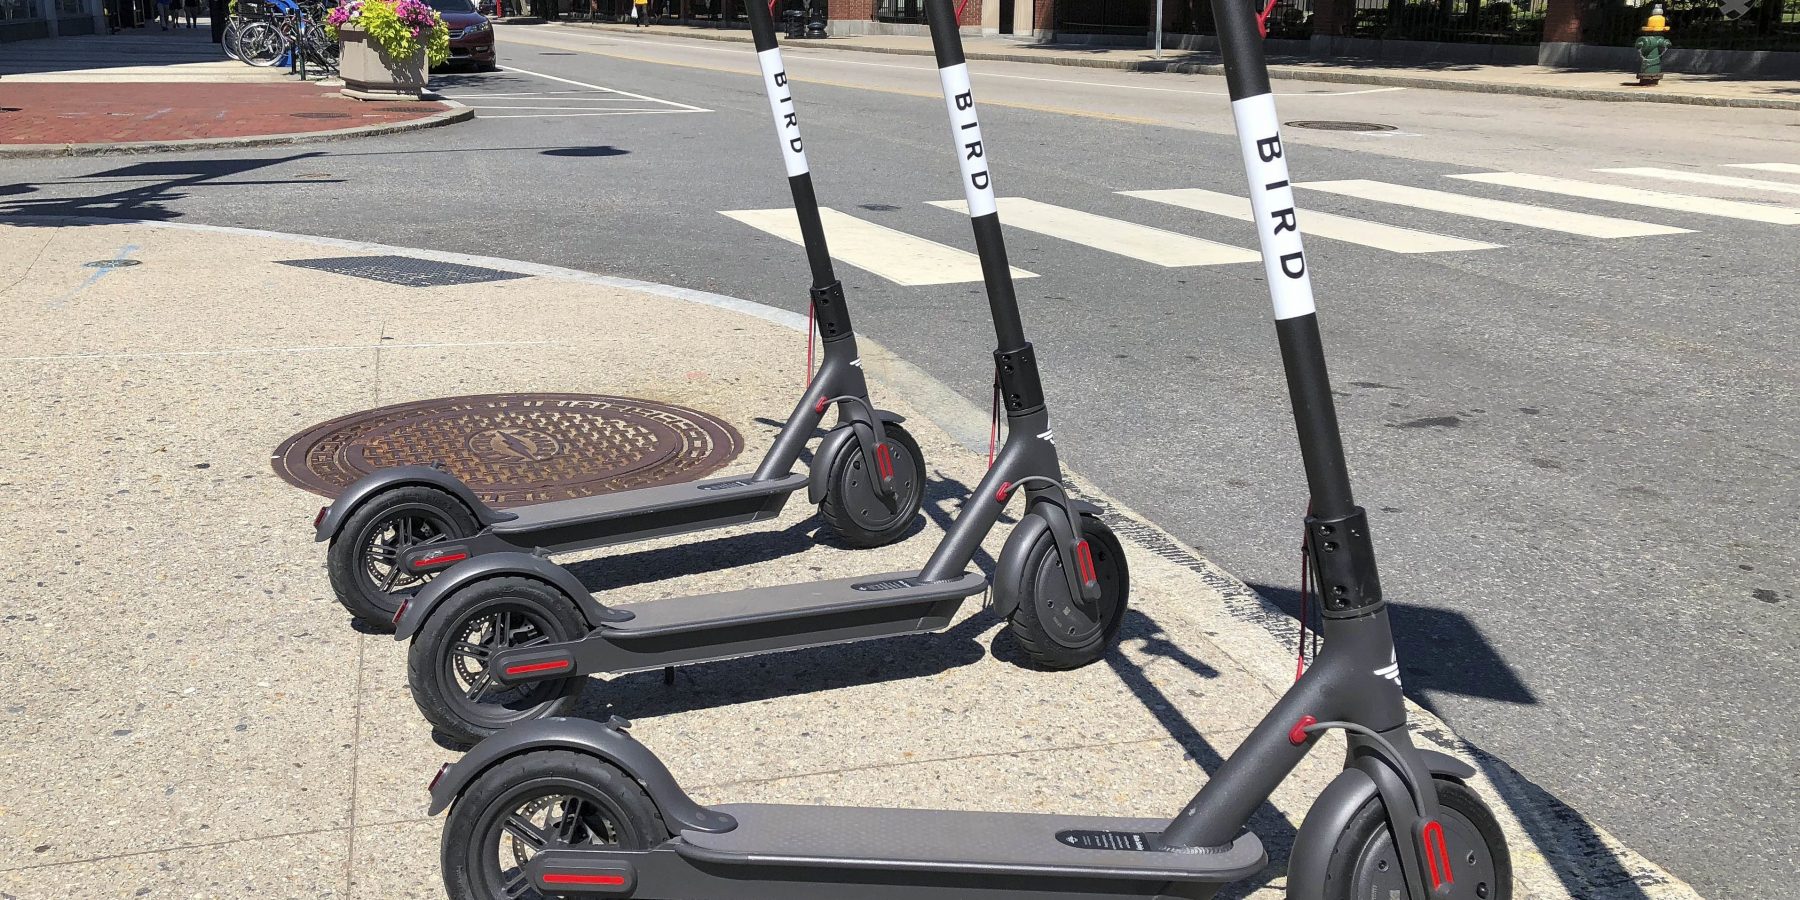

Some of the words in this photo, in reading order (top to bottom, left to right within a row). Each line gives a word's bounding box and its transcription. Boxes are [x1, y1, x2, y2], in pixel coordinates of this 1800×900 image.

[774, 71, 804, 153] BIRD
[955, 89, 989, 190] BIRD
[1257, 132, 1305, 279] BIRD
